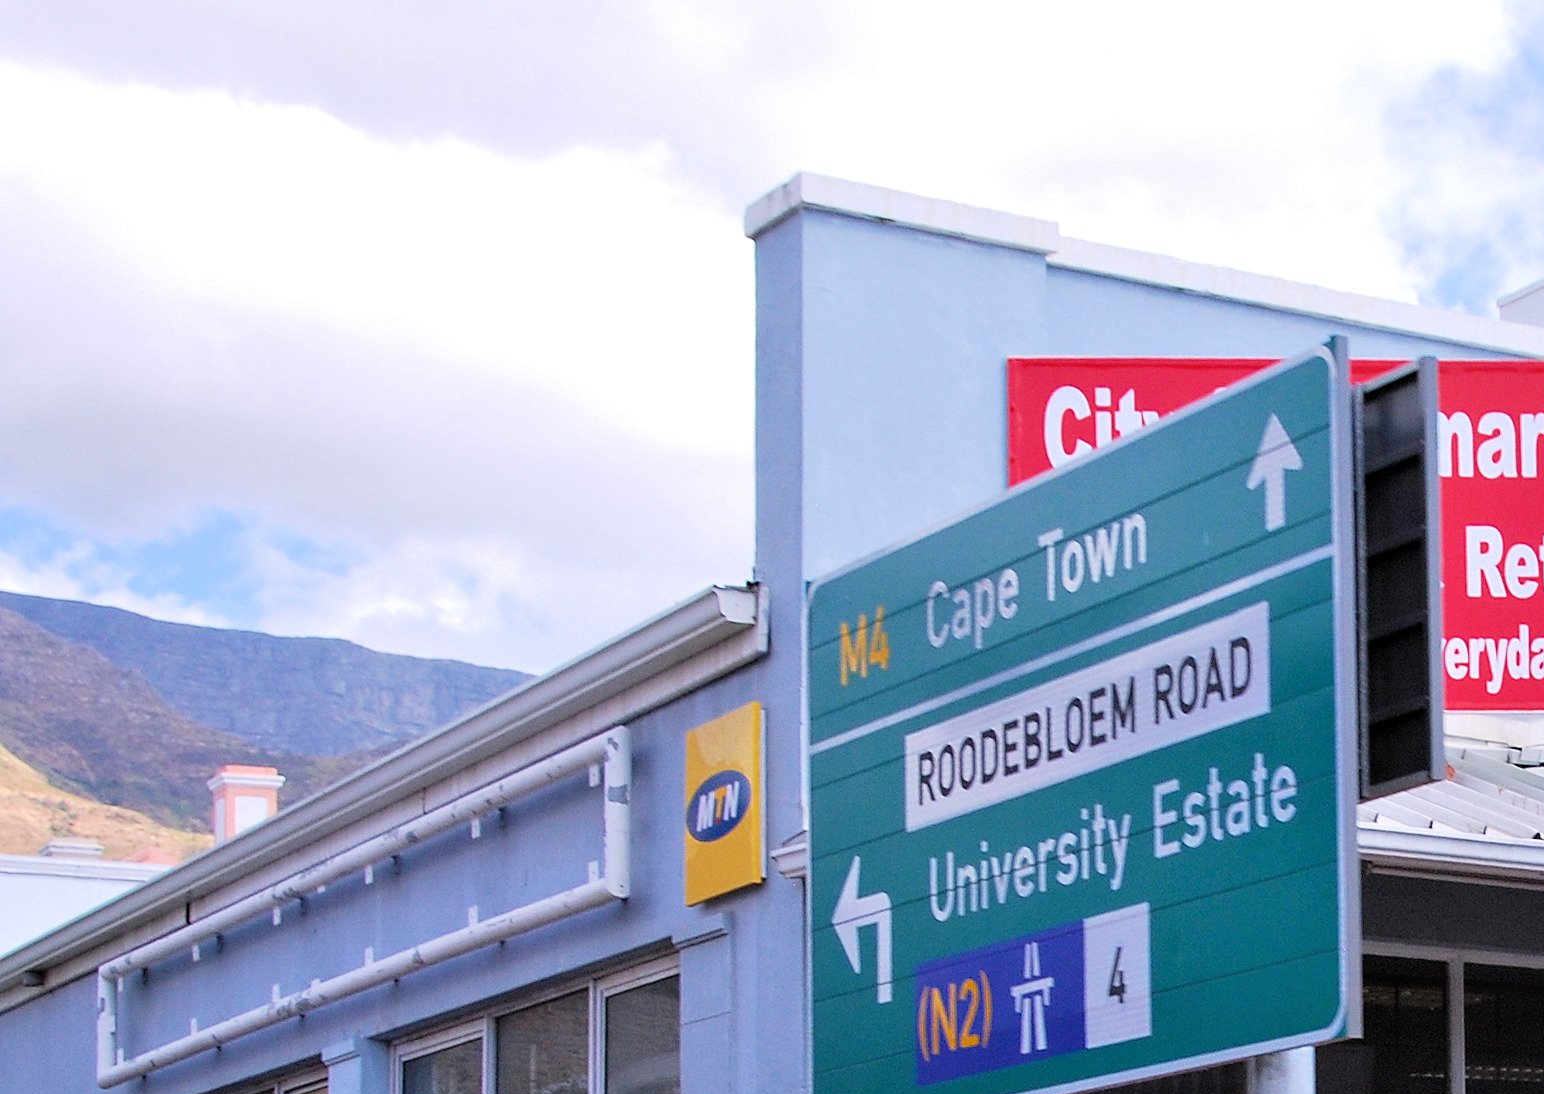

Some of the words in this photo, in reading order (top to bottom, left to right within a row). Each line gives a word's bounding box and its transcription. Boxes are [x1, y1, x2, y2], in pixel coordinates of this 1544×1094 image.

[1044, 385, 1174, 469] Cit
[839, 605, 890, 686] M4
[925, 567, 1020, 649] Cape
[1036, 511, 1148, 602] Town
[917, 674, 1137, 806] ROODEBLOEM
[1154, 636, 1252, 724] ROAD
[696, 780, 741, 832] MTN
[929, 804, 1132, 921] University
[1153, 752, 1299, 859] Estate
[918, 971, 993, 1063] (N2)
[1107, 946, 1126, 1005] 4
